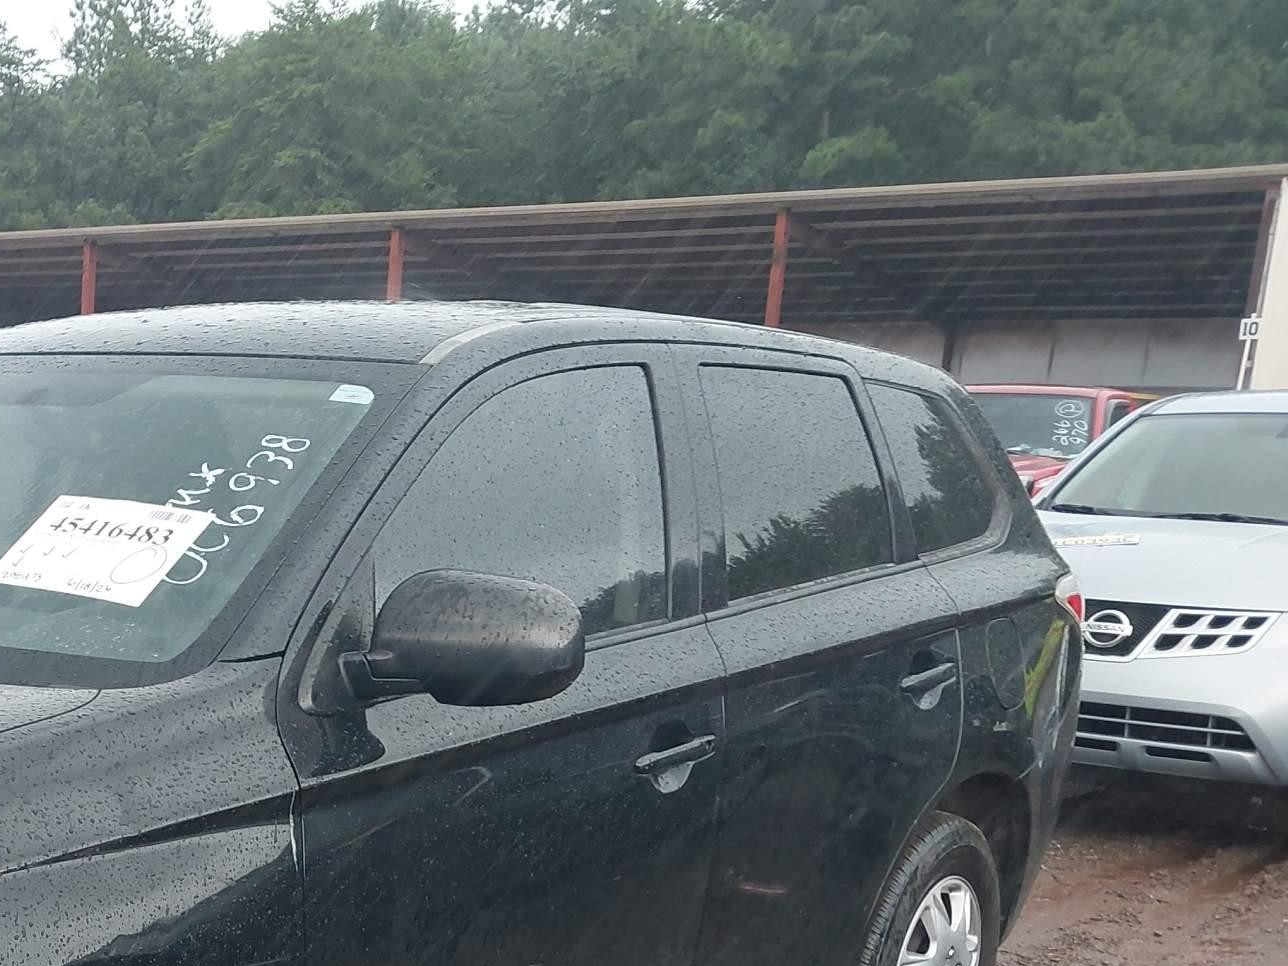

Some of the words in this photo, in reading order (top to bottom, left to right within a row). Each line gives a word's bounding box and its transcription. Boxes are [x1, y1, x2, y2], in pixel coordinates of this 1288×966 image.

[1242, 321, 1260, 337] 10
[1052, 419, 1071, 446] 266
[1069, 420, 1089, 444] 970
[48, 515, 175, 546] 45416483
